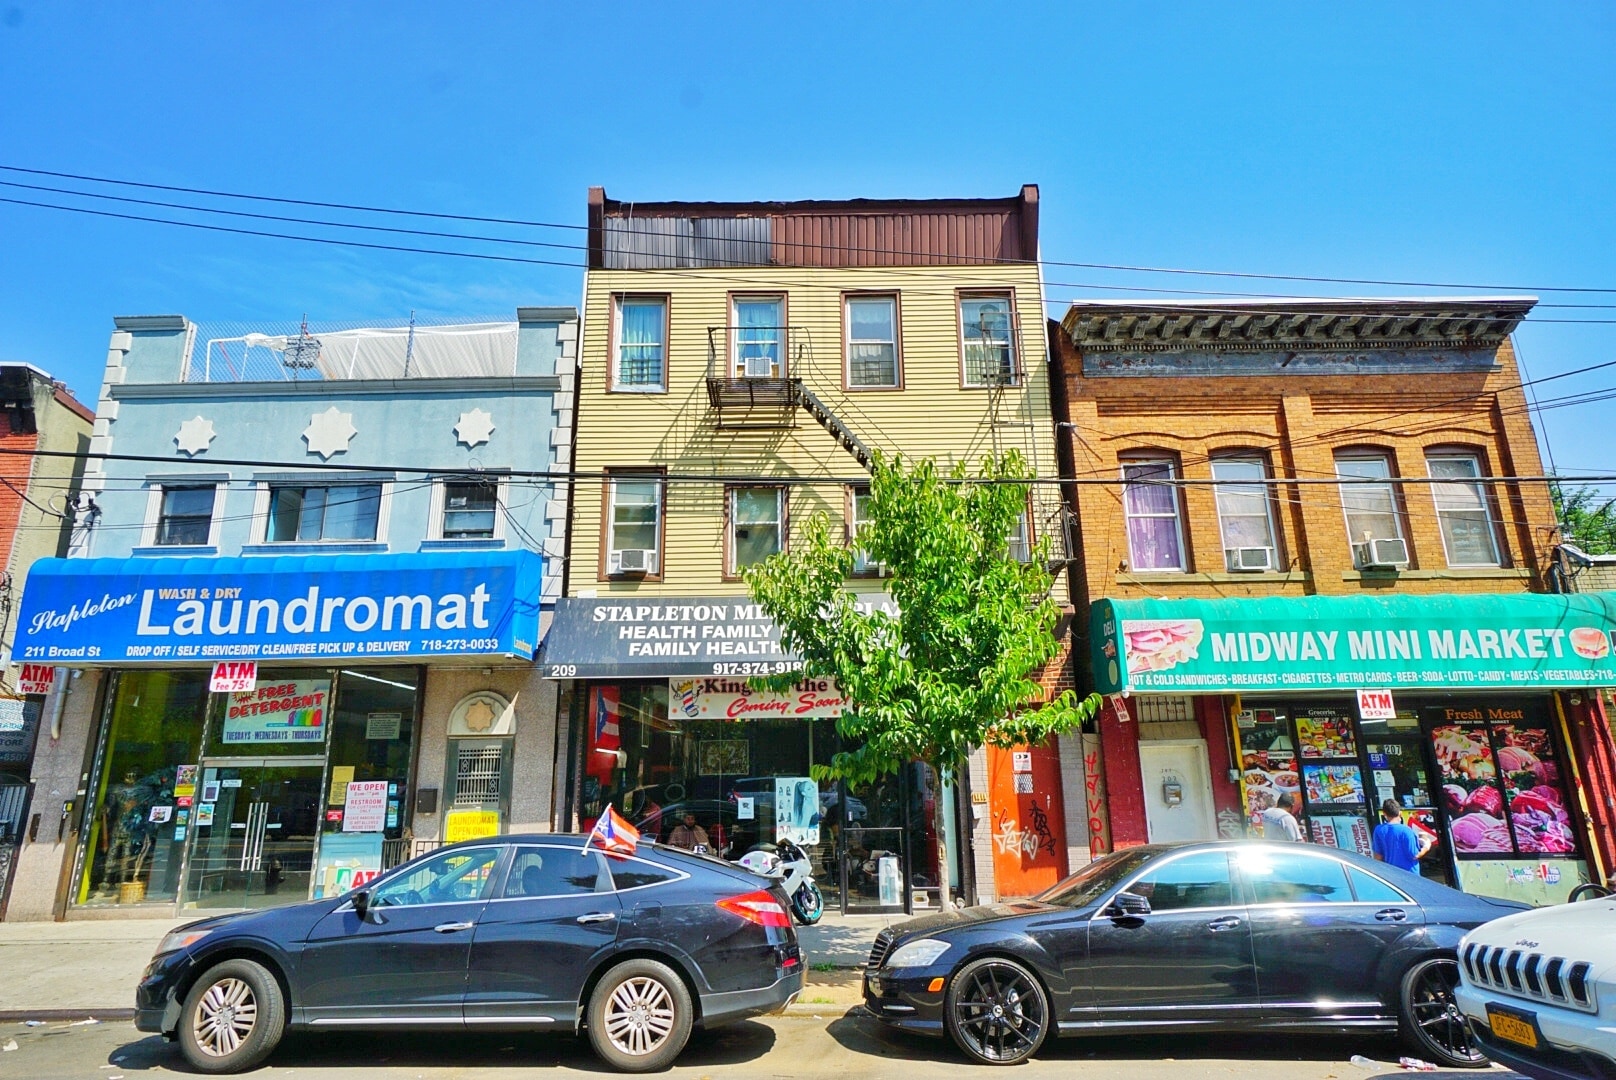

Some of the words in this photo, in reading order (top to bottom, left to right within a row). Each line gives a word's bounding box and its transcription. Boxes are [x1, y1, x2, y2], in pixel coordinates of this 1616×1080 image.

[158, 588, 195, 599] WASH
[200, 588, 210, 599] &
[214, 587, 242, 599] DRY
[27, 592, 138, 635] Stapleton
[136, 582, 491, 636] Laundromat
[592, 605, 727, 622] STAPLETON
[619, 625, 696, 639] HEALTH
[701, 625, 774, 639] FAMILY
[1103, 620, 1116, 636] DELI
[24, 646, 45, 657] 211
[48, 645, 84, 657] Broad
[87, 645, 101, 657] St
[126, 645, 150, 657] DROP
[153, 645, 171, 657] OFF
[177, 645, 200, 656] SELF
[318, 642, 341, 654] PICK
[342, 642, 356, 653] UP
[357, 641, 365, 653] &
[366, 640, 411, 653] DELIVERY
[421, 638, 499, 651] 718-273-0033
[629, 641, 702, 656] FAMILY
[706, 640, 783, 656] HEALTH
[1210, 630, 1339, 662] MIDWAY
[1347, 629, 1423, 660] MINI
[1428, 628, 1566, 659] MARKET
[20, 663, 54, 683] ATM
[213, 662, 255, 680] ATM
[552, 664, 577, 677] 209
[1128, 674, 1144, 686] HOT
[1146, 674, 1153, 685] &
[1153, 674, 1175, 686] COLD
[1175, 673, 1229, 685] SANDWICHES
[1231, 673, 1278, 684] BREAKFAST
[1335, 672, 1364, 683] METRO
[1365, 671, 1393, 683] CARDS
[1396, 671, 1419, 682] BEER
[1421, 671, 1444, 682] SODA
[1447, 671, 1475, 682] LOTTO
[1478, 670, 1505, 682] CANDY
[1509, 670, 1540, 681] MEATS
[1542, 669, 1596, 681] VEGETABLES
[21, 683, 33, 693] Fee
[215, 682, 230, 691] Fee
[257, 683, 298, 700] FREE
[796, 678, 828, 693] the
[228, 692, 326, 719] DETERGENT
[726, 697, 791, 718] Coming
[794, 692, 851, 714] Soon!
[1361, 694, 1392, 709] ATM
[1444, 708, 1484, 719] Fresh
[1487, 708, 1524, 719] Meat
[226, 731, 251, 741] TUESDAYS
[254, 730, 288, 740] WEDNESDAYS
[291, 730, 322, 740] THURSDAYS
[1385, 745, 1401, 754] 207
[1370, 753, 1384, 762] EBT
[364, 783, 386, 791] OPEN
[449, 815, 495, 826] LAUNDROMAT
[452, 826, 471, 836] OPEN
[472, 826, 490, 836] ONLY
[1322, 825, 1336, 848] FOO
[1515, 938, 1540, 948] Jeep
